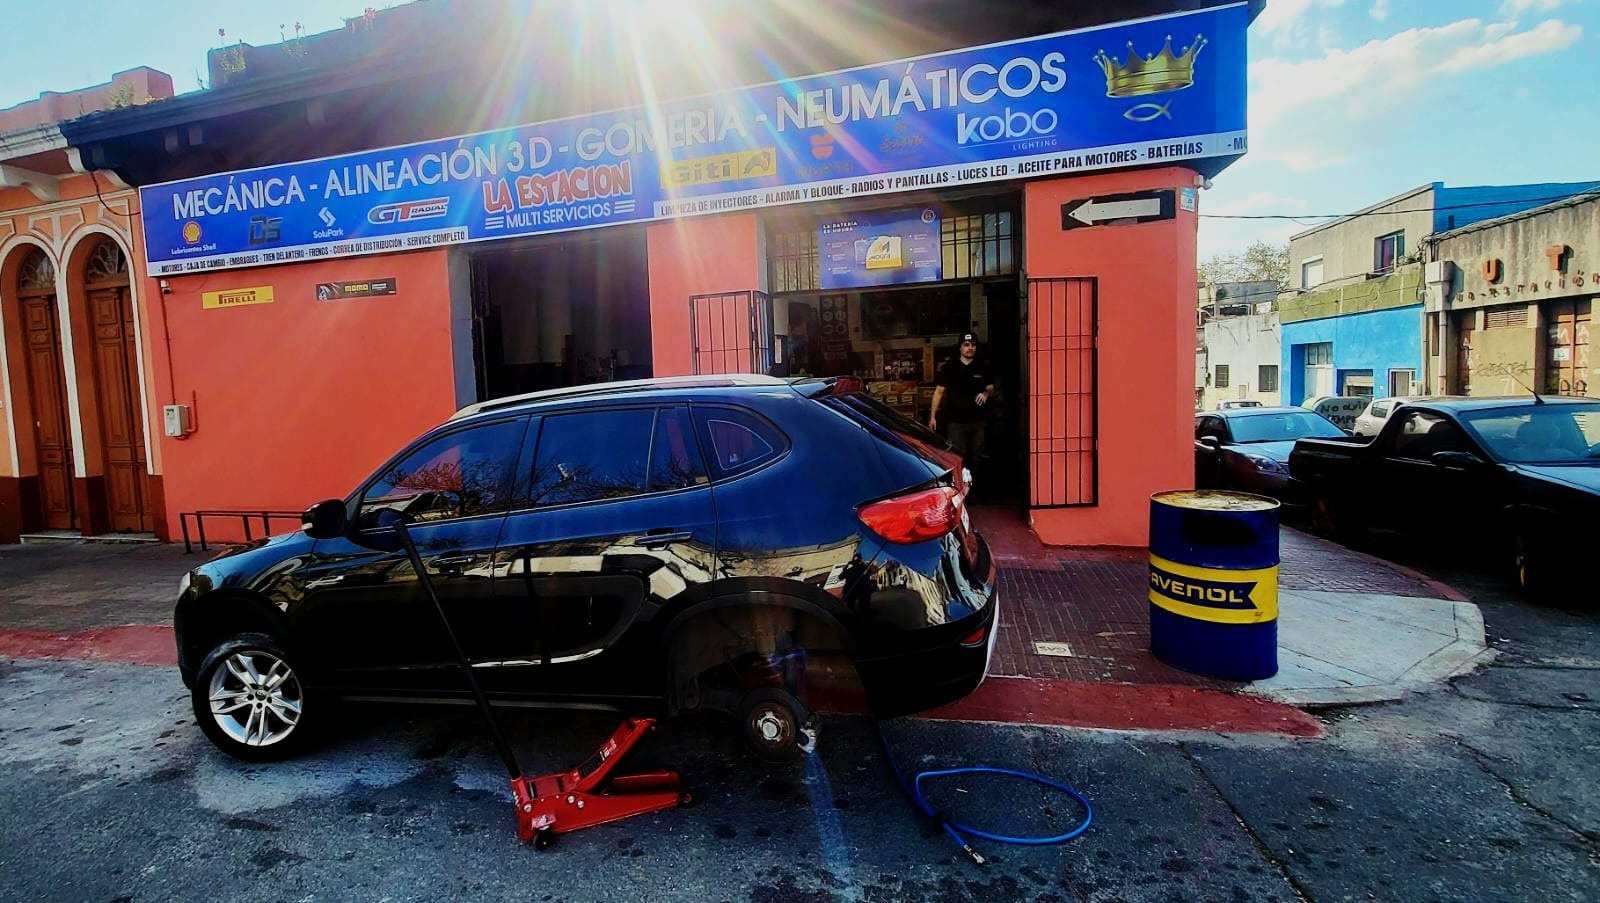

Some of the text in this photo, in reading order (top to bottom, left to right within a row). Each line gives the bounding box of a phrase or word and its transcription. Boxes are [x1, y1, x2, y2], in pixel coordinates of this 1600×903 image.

[173, 175, 305, 220] MECÁNICA
[324, 139, 497, 199] ALINEACIÓN
[777, 52, 1067, 132] NEUMÁTICOS
[1012, 138, 1058, 151] LIGHTING
[483, 159, 633, 213] LA ESTACION
[698, 201, 709, 212] DE
[709, 195, 758, 210] INYECTORES
[765, 190, 800, 204] ALARMA
[810, 184, 844, 198] BLOQUE
[851, 179, 885, 193] RADIOS
[895, 171, 949, 188] PANTALLAS
[957, 164, 988, 181] LUCES
[990, 162, 1008, 177] LED
[1018, 156, 1051, 174] ACEITE
[1054, 153, 1082, 170] PARA
[1085, 149, 1137, 166] MOTORES
[1148, 141, 1203, 159] BATERÍAS
[411, 204, 447, 215] RADIAL
[506, 202, 611, 229] MULTI SERVICIOS
[313, 228, 344, 239] SoluPark
[161, 263, 184, 273] MOTORES
[186, 261, 200, 270] CAJA
[206, 258, 226, 268] CAMBIO
[229, 255, 259, 266] EMBRAGUES
[263, 252, 276, 262] TREN
[276, 250, 304, 261] DELANTERO
[309, 246, 329, 256] FRENOS
[333, 243, 355, 254] CORREA
[364, 238, 402, 251] DISTRIBUCIÓN
[407, 235, 431, 246] SERVICE
[433, 230, 465, 244] COMPLETO
[218, 290, 256, 305] PIRELLI
[1149, 572, 1243, 603] AVENOL
